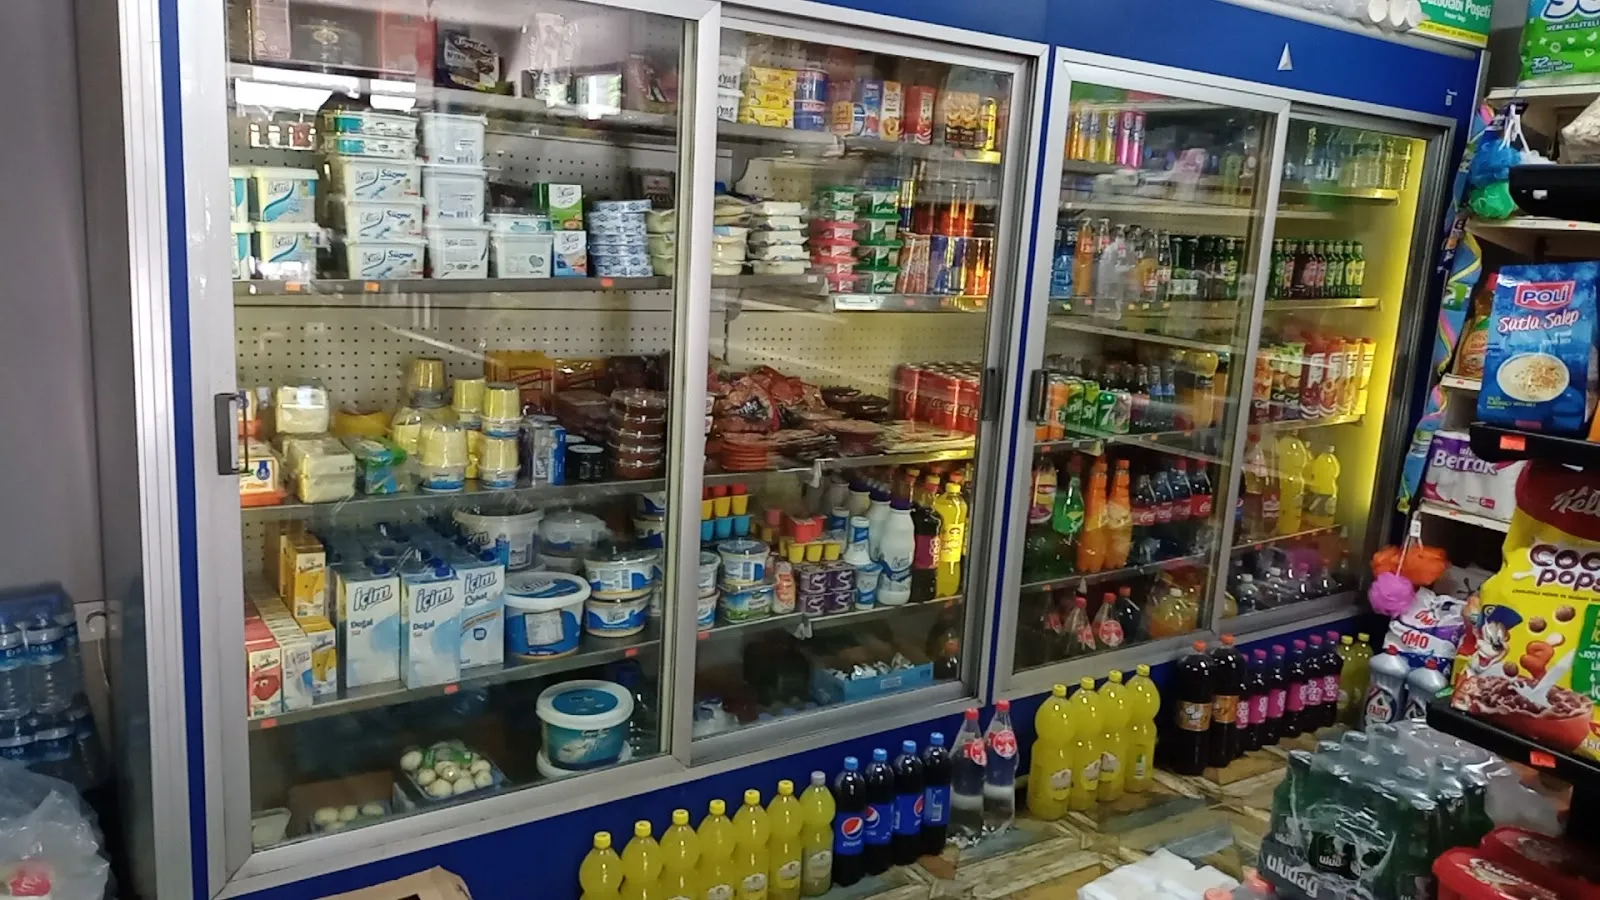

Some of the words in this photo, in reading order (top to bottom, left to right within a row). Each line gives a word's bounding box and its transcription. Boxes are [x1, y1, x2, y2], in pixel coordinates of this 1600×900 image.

[1432, 449, 1498, 475] Berrak
[1401, 630, 1429, 649] OMO
[1368, 704, 1389, 719] FAIRY
